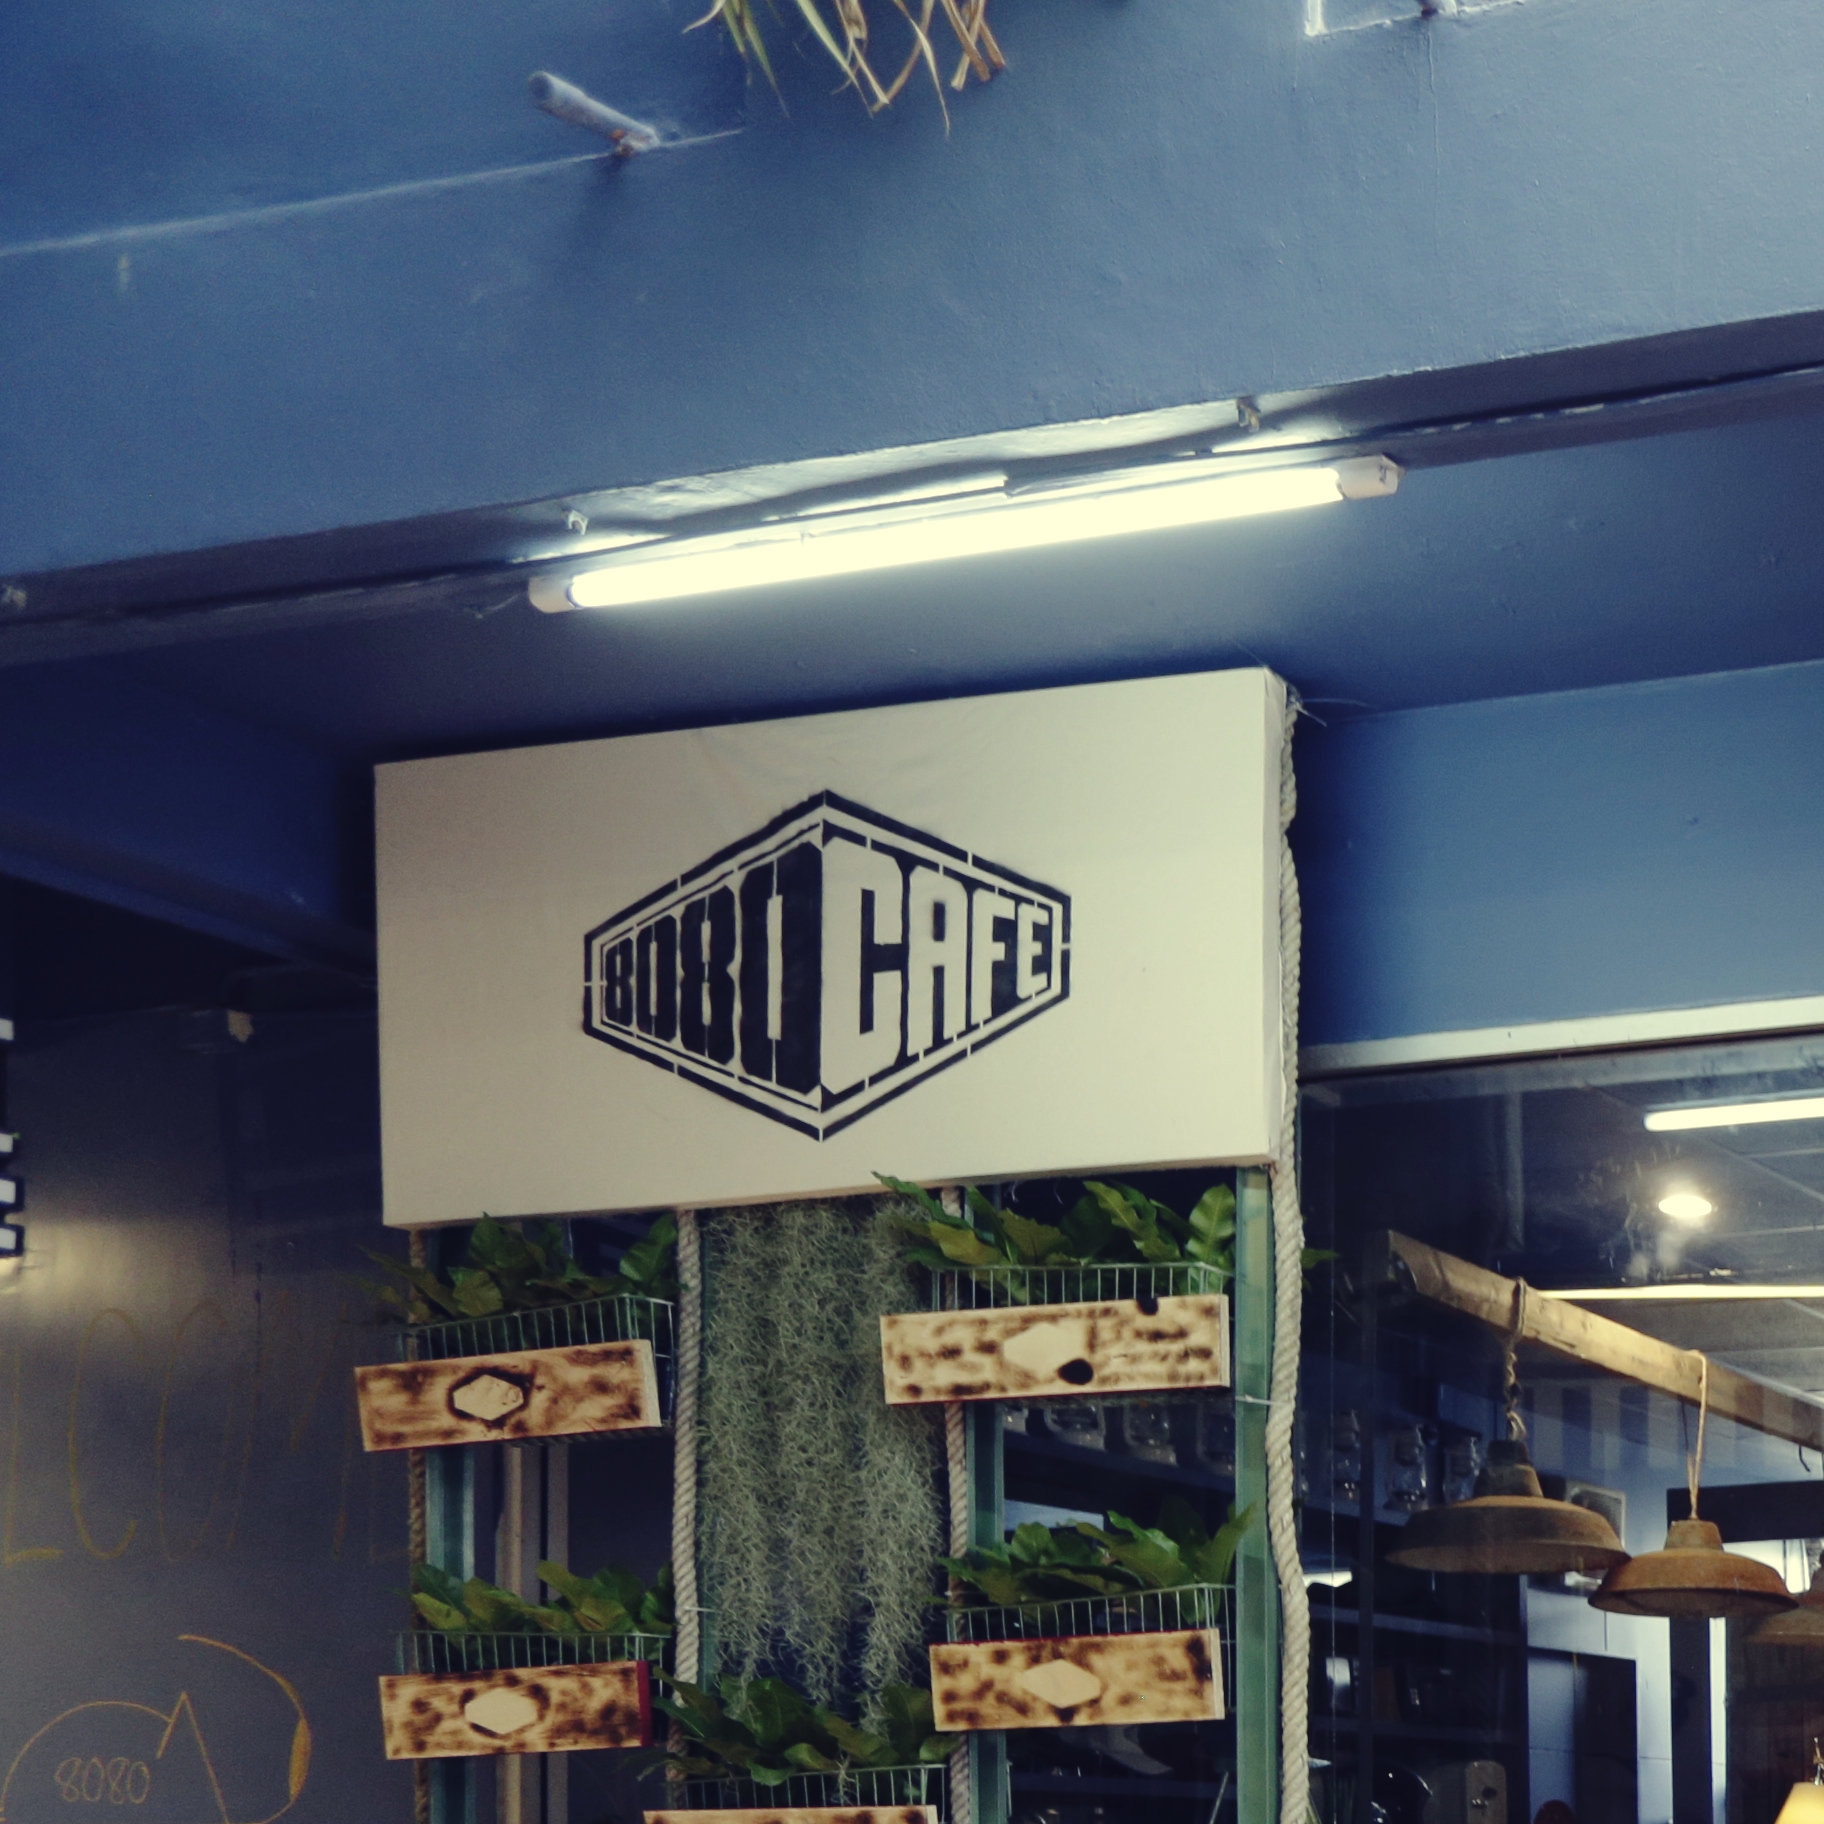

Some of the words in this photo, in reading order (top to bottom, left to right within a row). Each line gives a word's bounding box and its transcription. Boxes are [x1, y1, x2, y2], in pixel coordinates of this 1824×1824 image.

[602, 842, 822, 1096] 8080
[823, 837, 1049, 1093] CAFE
[53, 1755, 152, 1804] 8080
